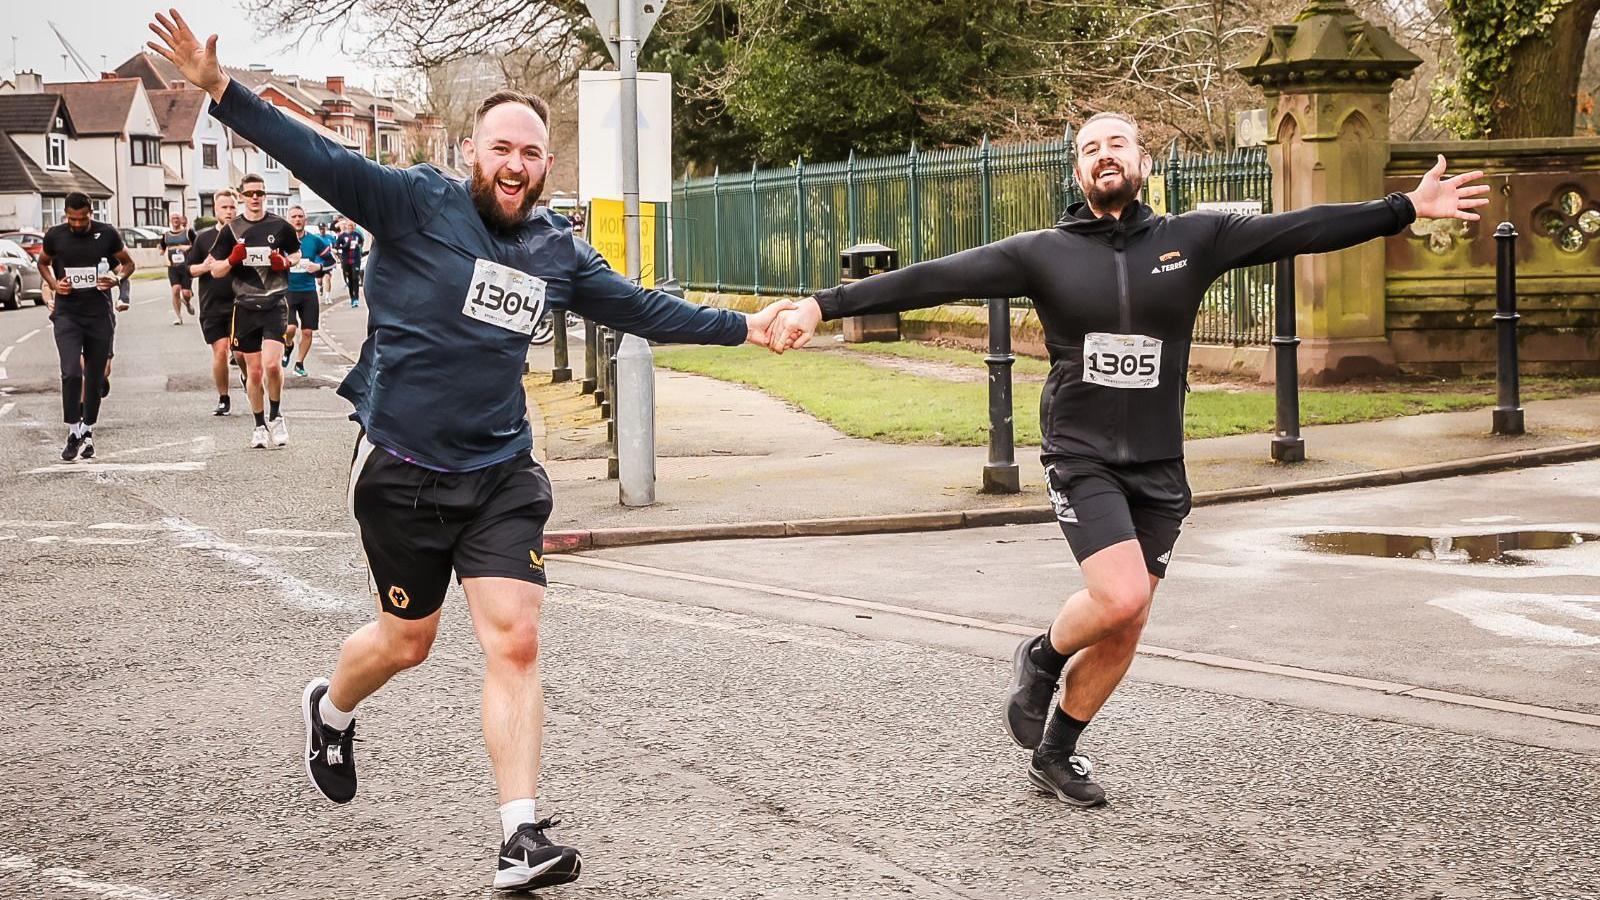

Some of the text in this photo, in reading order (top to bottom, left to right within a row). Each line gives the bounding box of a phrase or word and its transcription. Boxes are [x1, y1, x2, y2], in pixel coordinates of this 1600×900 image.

[250, 254, 263, 262] 74
[1161, 259, 1188, 272] TERREX
[68, 274, 96, 284] 1049
[471, 281, 540, 322] 1304
[1088, 352, 1156, 376] 1305
